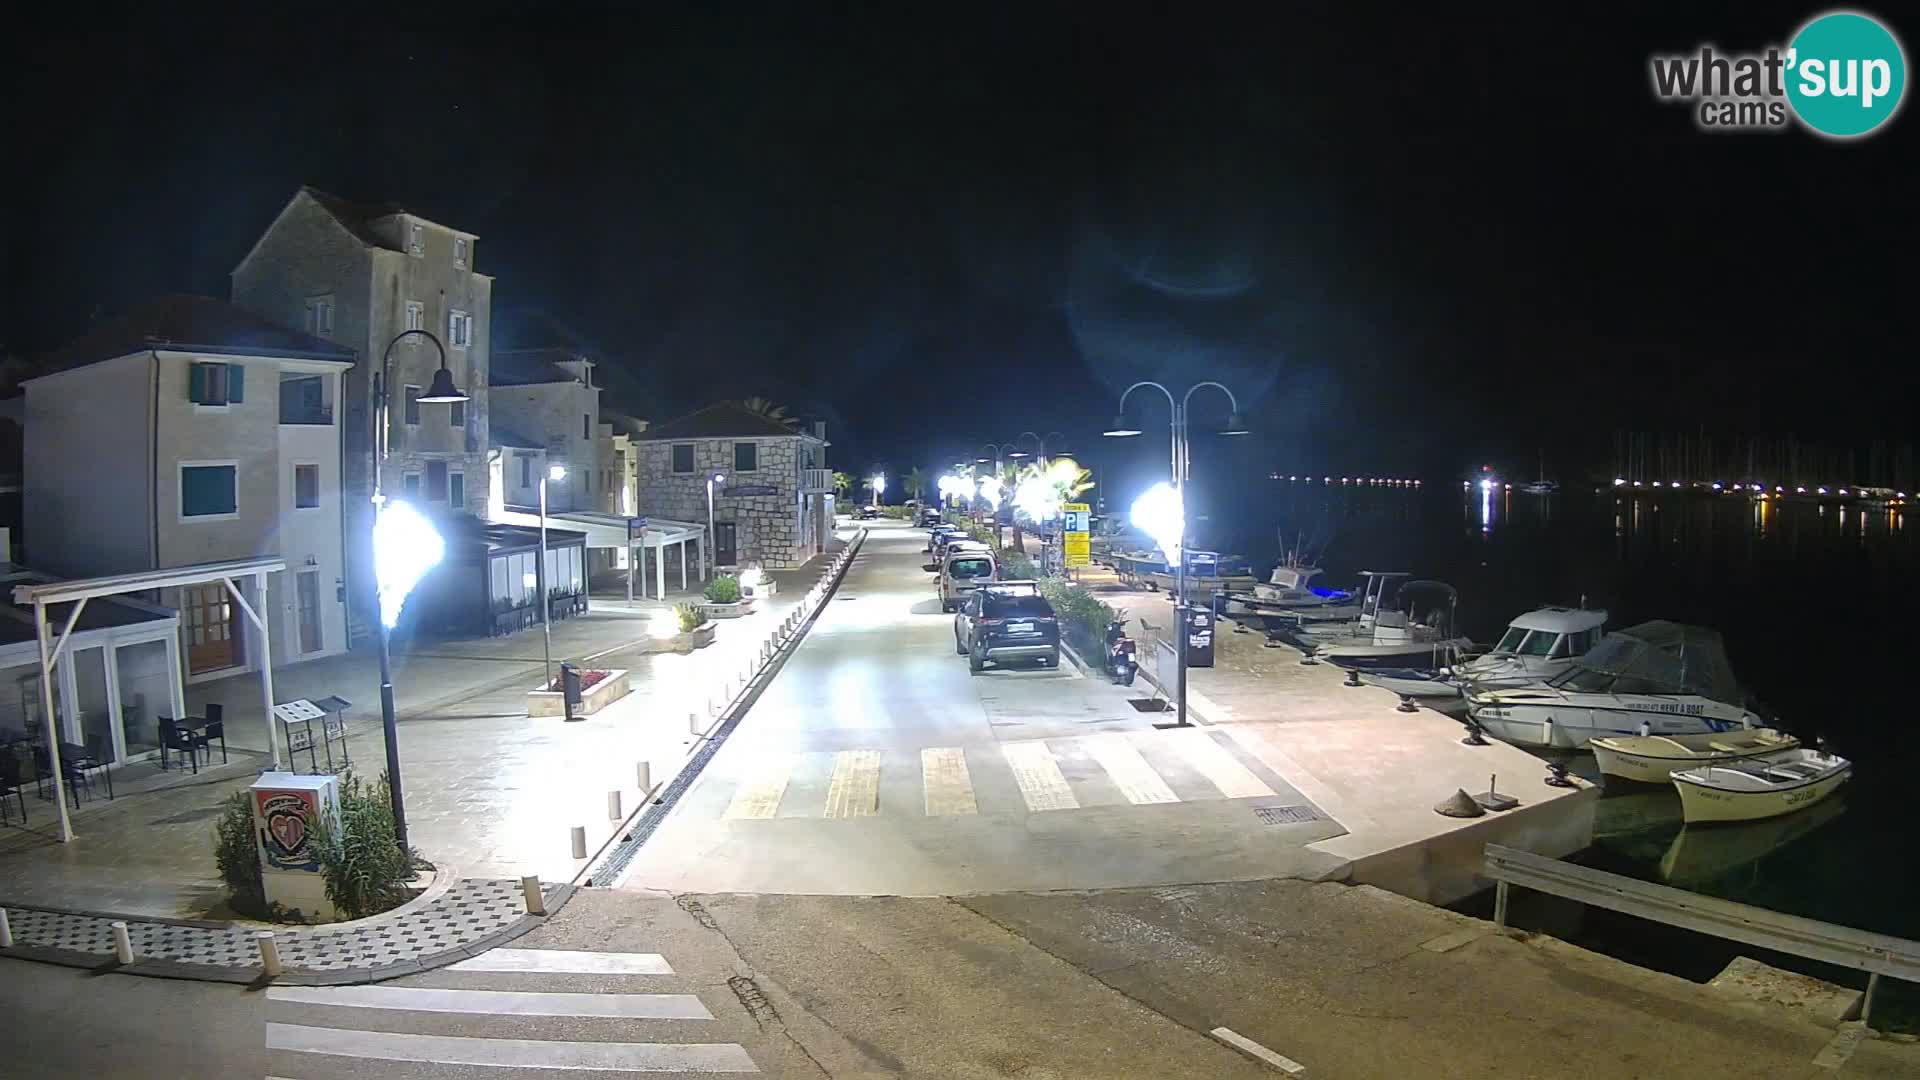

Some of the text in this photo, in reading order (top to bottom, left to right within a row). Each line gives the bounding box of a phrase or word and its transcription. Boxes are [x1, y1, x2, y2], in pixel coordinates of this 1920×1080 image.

[1066, 513, 1076, 530] P
[1660, 703, 1679, 713] RENT
[1686, 704, 1704, 716] BOAT
